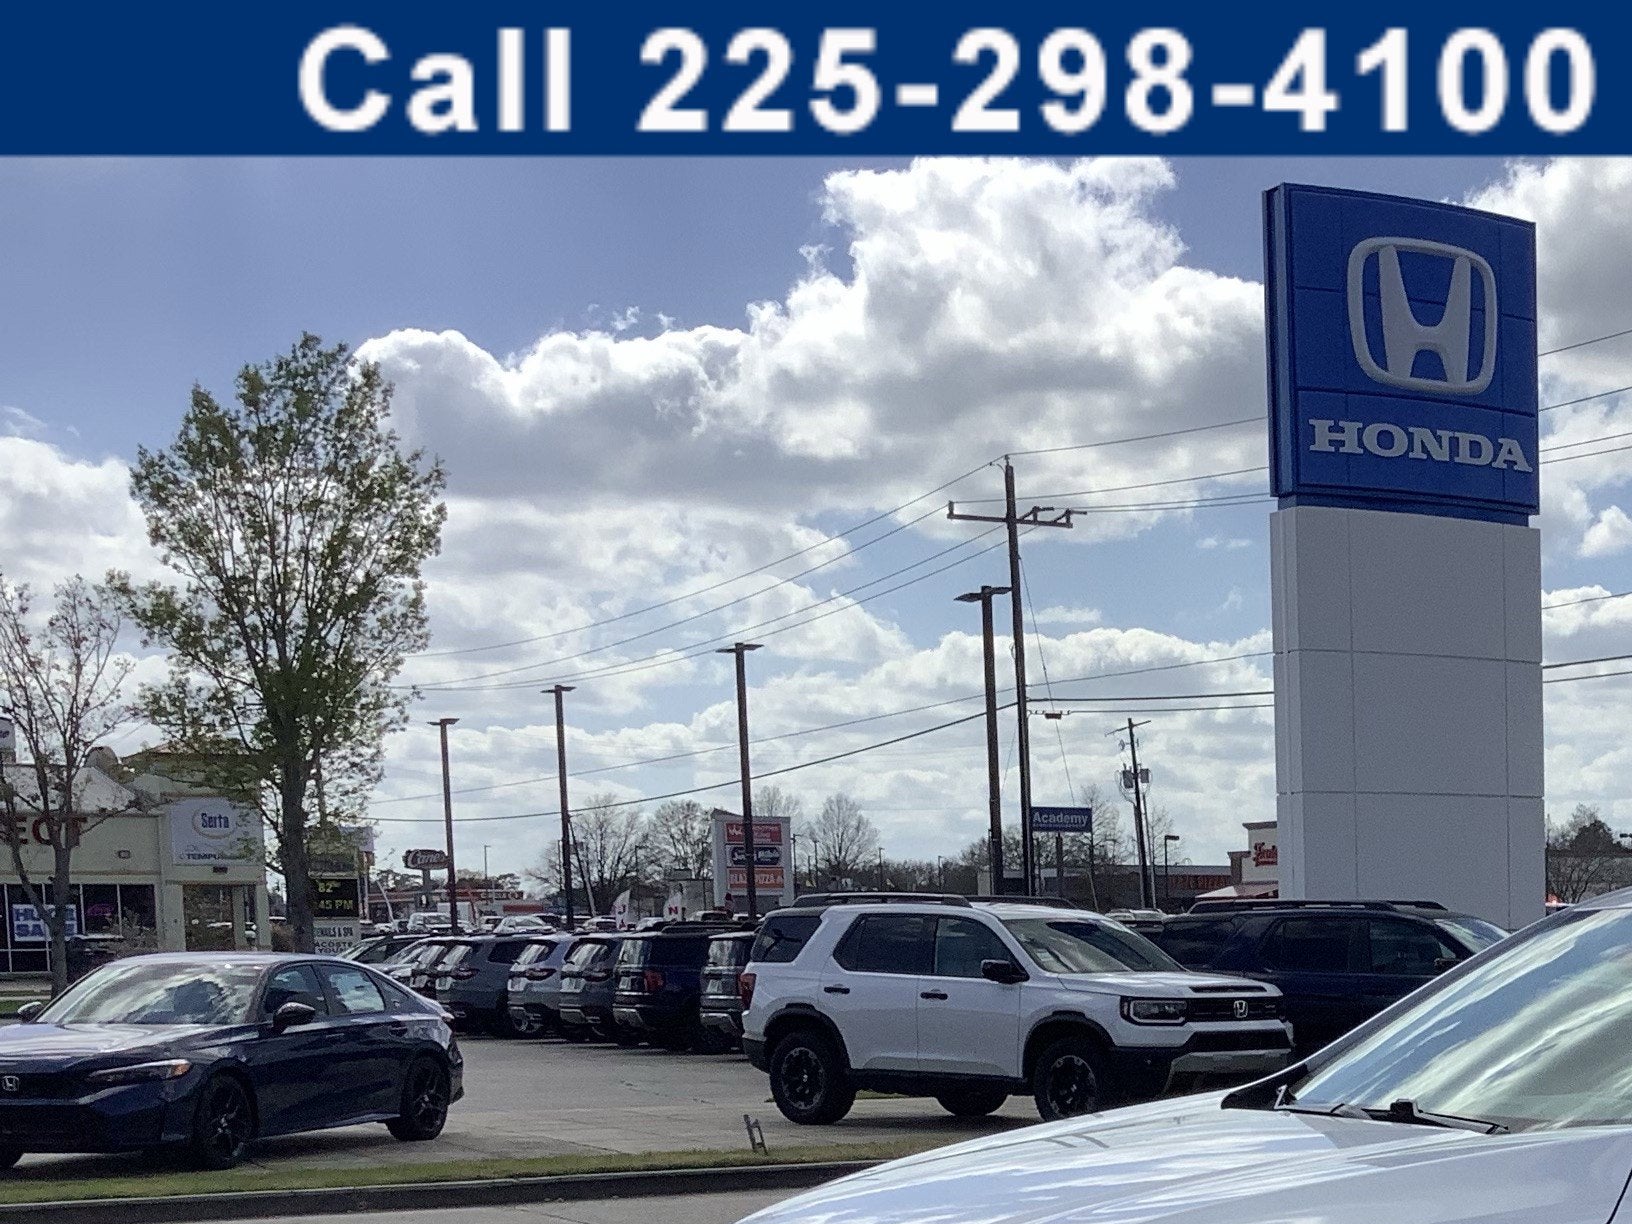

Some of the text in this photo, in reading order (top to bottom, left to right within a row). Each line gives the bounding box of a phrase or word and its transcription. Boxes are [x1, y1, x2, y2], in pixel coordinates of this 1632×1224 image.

[1308, 417, 1534, 473] HONDA
[201, 812, 230, 829] Serta
[1032, 811, 1089, 827] Academy
